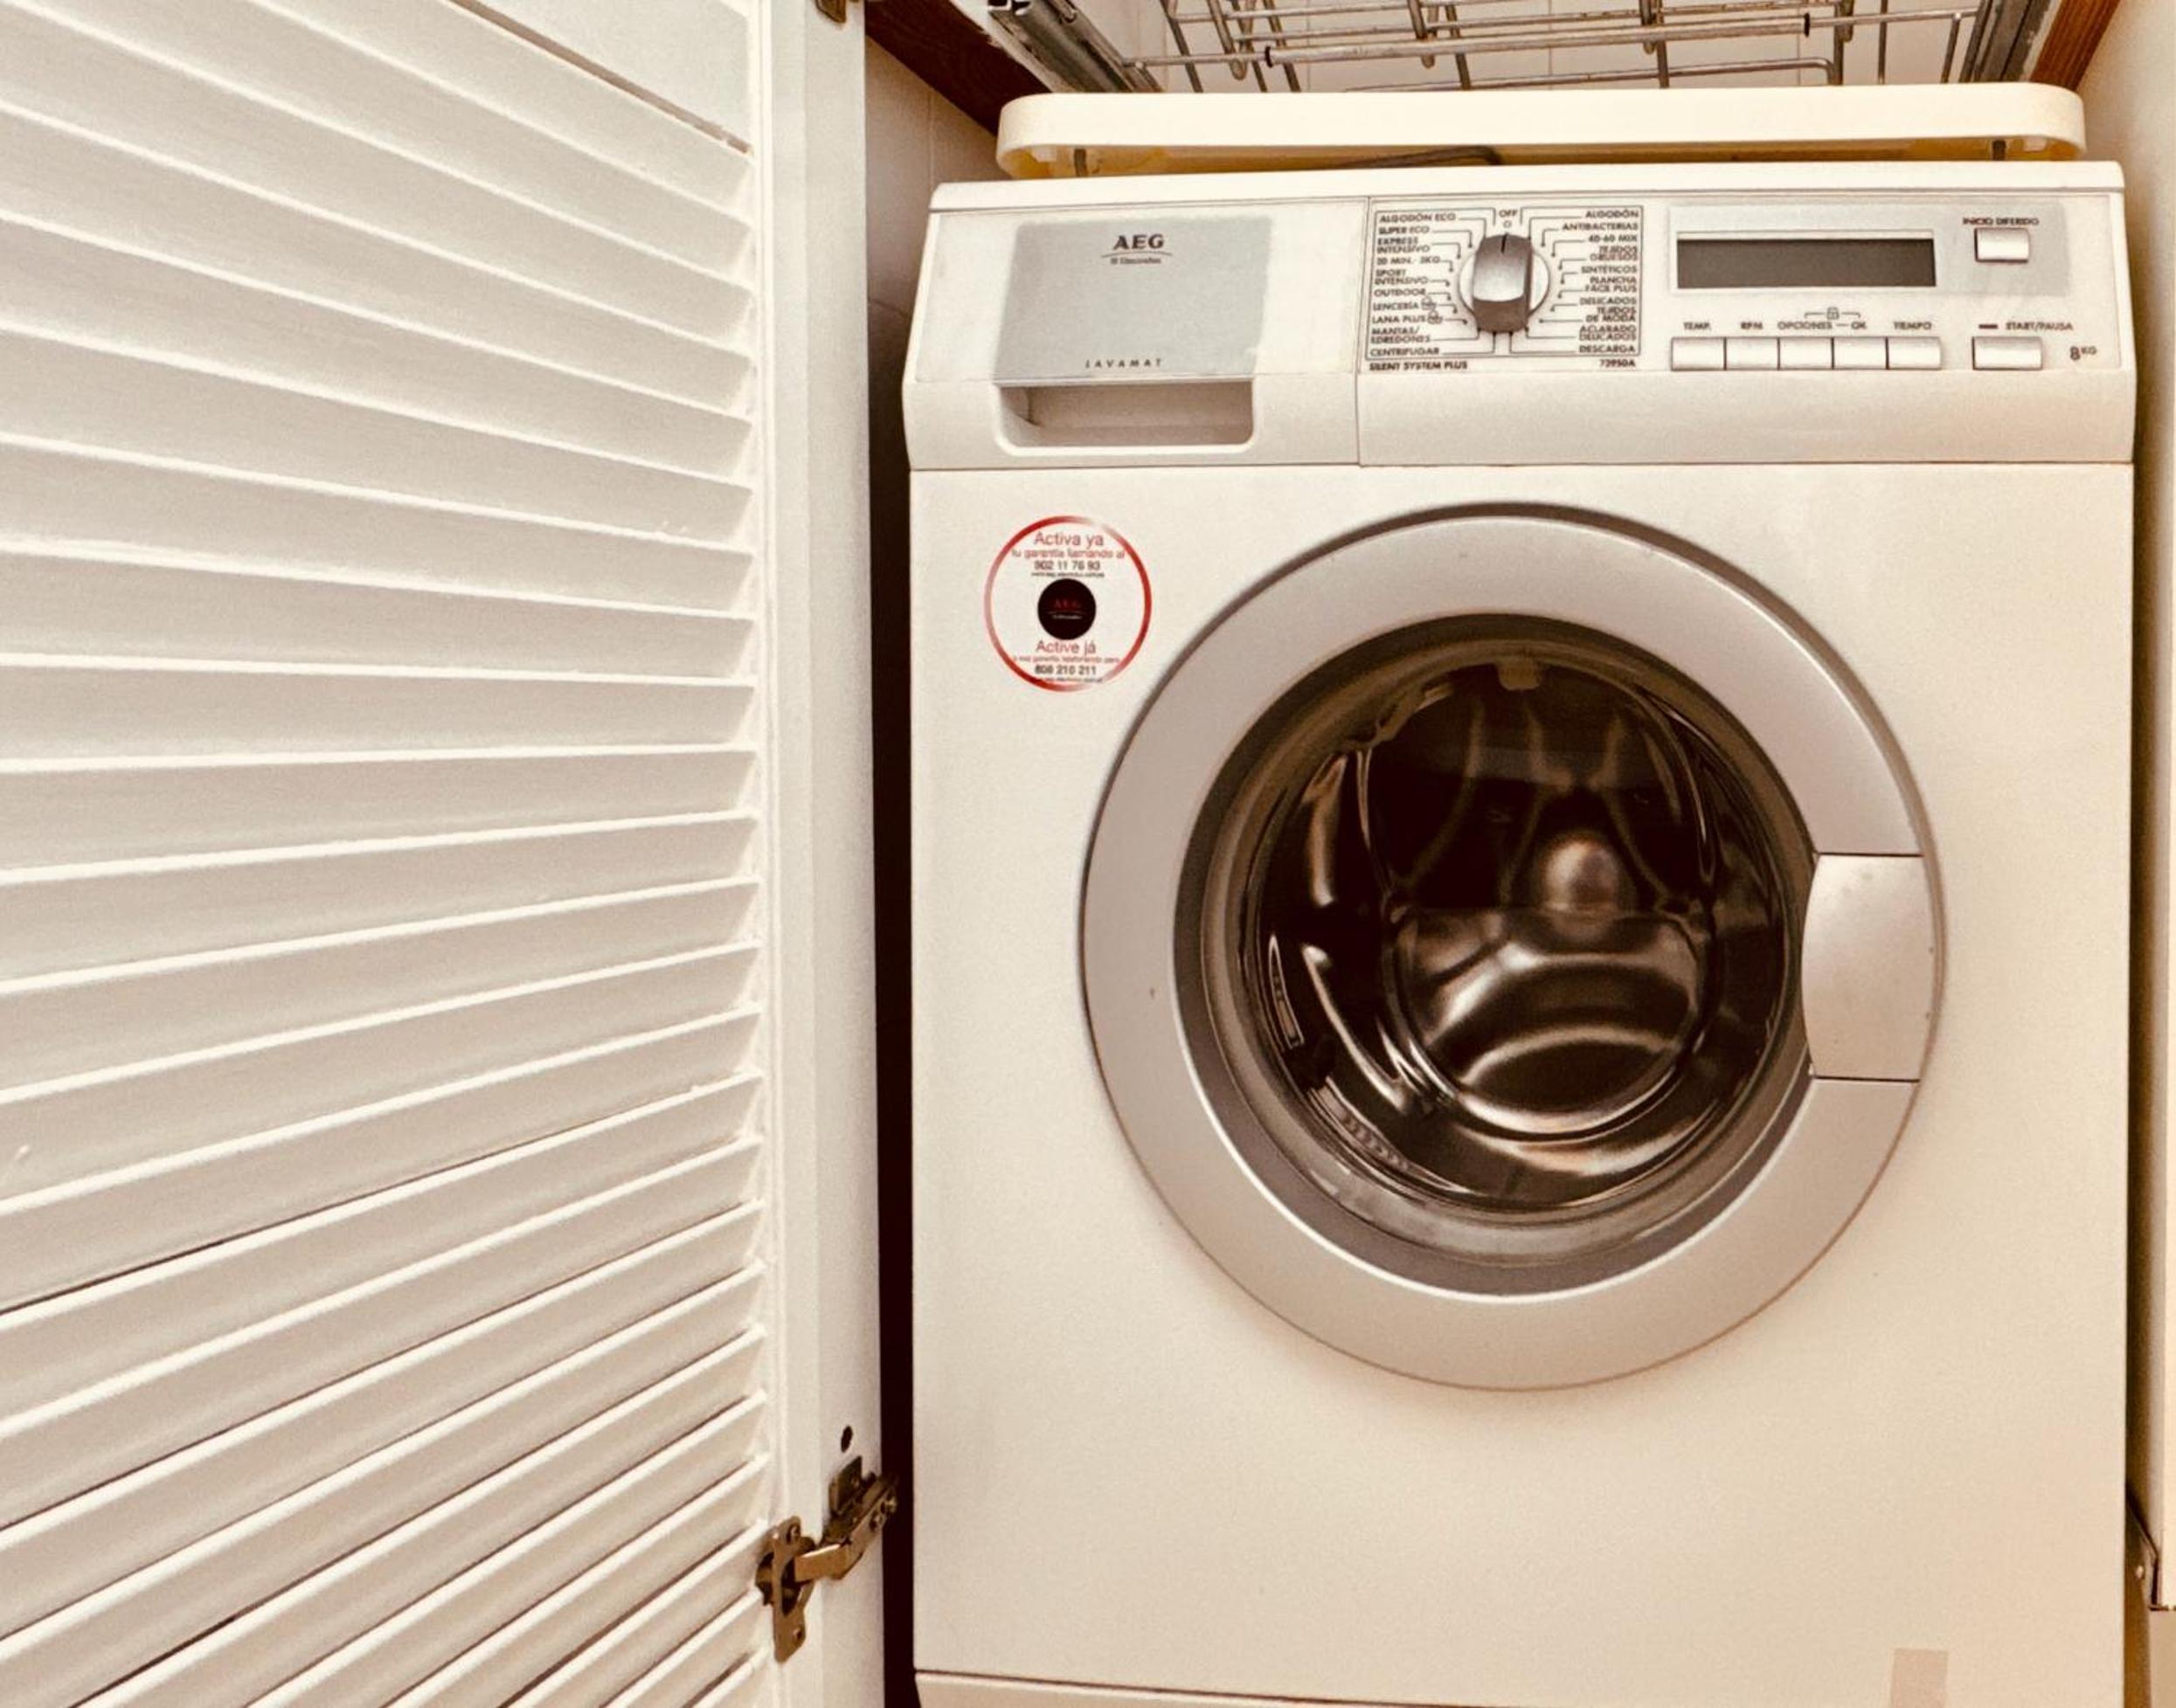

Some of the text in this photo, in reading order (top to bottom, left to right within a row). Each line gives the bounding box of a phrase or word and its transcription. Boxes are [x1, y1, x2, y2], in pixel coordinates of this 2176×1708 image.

[1380, 212, 1456, 223] ALGODÓN ECO
[1585, 209, 1639, 218] ALGODÓN
[1995, 217, 2040, 225] DIFERIDO
[1410, 225, 1430, 234] ECO
[1562, 222, 1638, 231] ANTIBACTERIAS
[1112, 233, 1164, 250] AEG
[1376, 245, 1430, 254] INTENSIVO
[1376, 268, 1406, 277] SPORT
[1375, 276, 1428, 285] INTENSIVO
[1374, 288, 1425, 297] OUTDOOR
[1613, 284, 1637, 293] PLUS
[1579, 296, 1637, 305] DELICADOS
[1372, 315, 1425, 324] LANA PLUS
[1740, 322, 1764, 330] RPM
[1778, 321, 1833, 330] OPCIONES
[1850, 321, 1867, 330] OK
[2006, 322, 2074, 331] START/PAUSA
[1370, 348, 1439, 356] CENTRIFUGAR
[1085, 357, 1161, 369] LAVAMAT
[1369, 361, 1467, 370] SILENT SYSTEM PLUS
[1034, 531, 1104, 550] Activa ya
[1057, 560, 1068, 570] 11
[1036, 640, 1080, 653] Active
